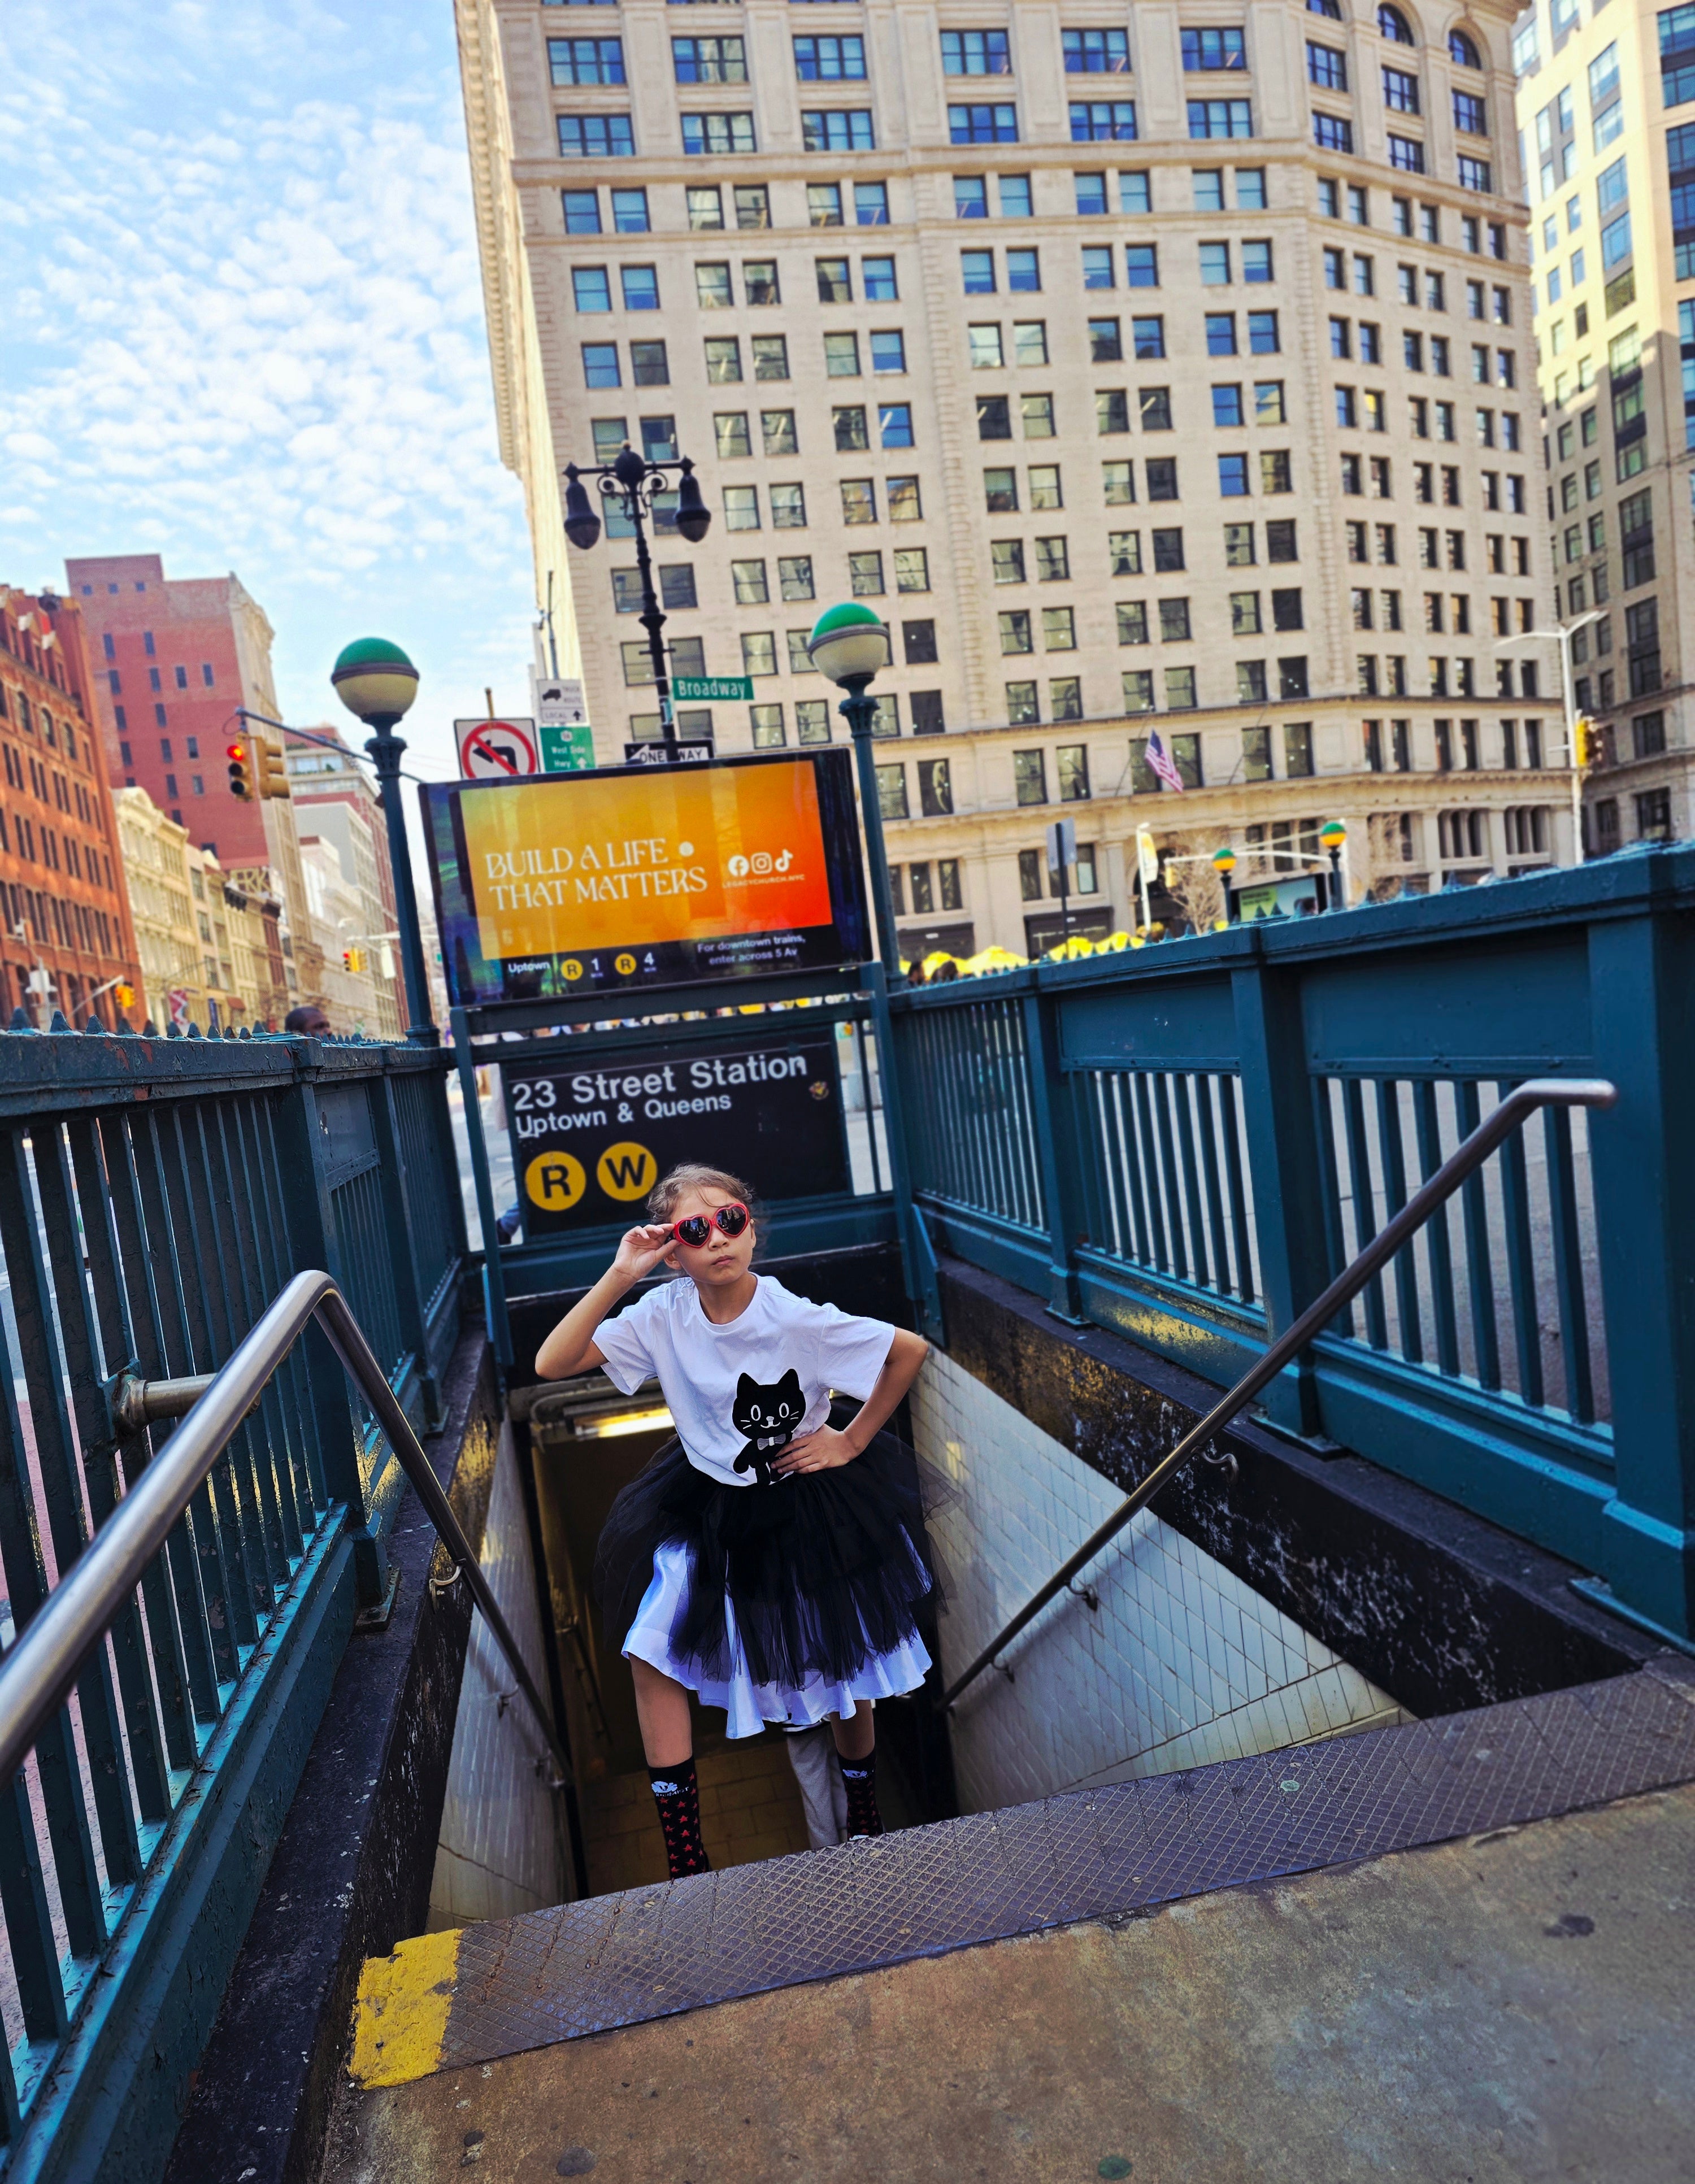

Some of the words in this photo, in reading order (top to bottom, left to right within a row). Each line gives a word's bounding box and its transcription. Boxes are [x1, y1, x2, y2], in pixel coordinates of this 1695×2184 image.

[678, 680, 745, 700] Broadway
[640, 750, 664, 763] ONE
[677, 749, 703, 762] WAY
[485, 847, 573, 879] BUILD
[580, 845, 601, 871] A
[606, 837, 668, 868] LIFE
[489, 879, 567, 911] THAT
[575, 866, 707, 903] MATTERS
[697, 943, 714, 952] For
[718, 938, 771, 951] downtown
[773, 934, 806, 945] trains,
[709, 955, 735, 965] enter
[738, 951, 773, 962] across
[775, 948, 782, 958] 5
[784, 947, 798, 956] Av
[508, 961, 551, 974] Uptown
[567, 963, 577, 976] R
[592, 958, 599, 971] 1
[620, 958, 631, 971] R
[644, 951, 654, 965] 4
[512, 1081, 556, 1111] 23
[571, 1066, 674, 1104] Street
[690, 1054, 807, 1089] Station
[515, 1110, 607, 1138] Uptown
[617, 1104, 633, 1123] &
[644, 1094, 732, 1119] Queens
[541, 1164, 571, 1199] R
[606, 1154, 646, 1189] W
